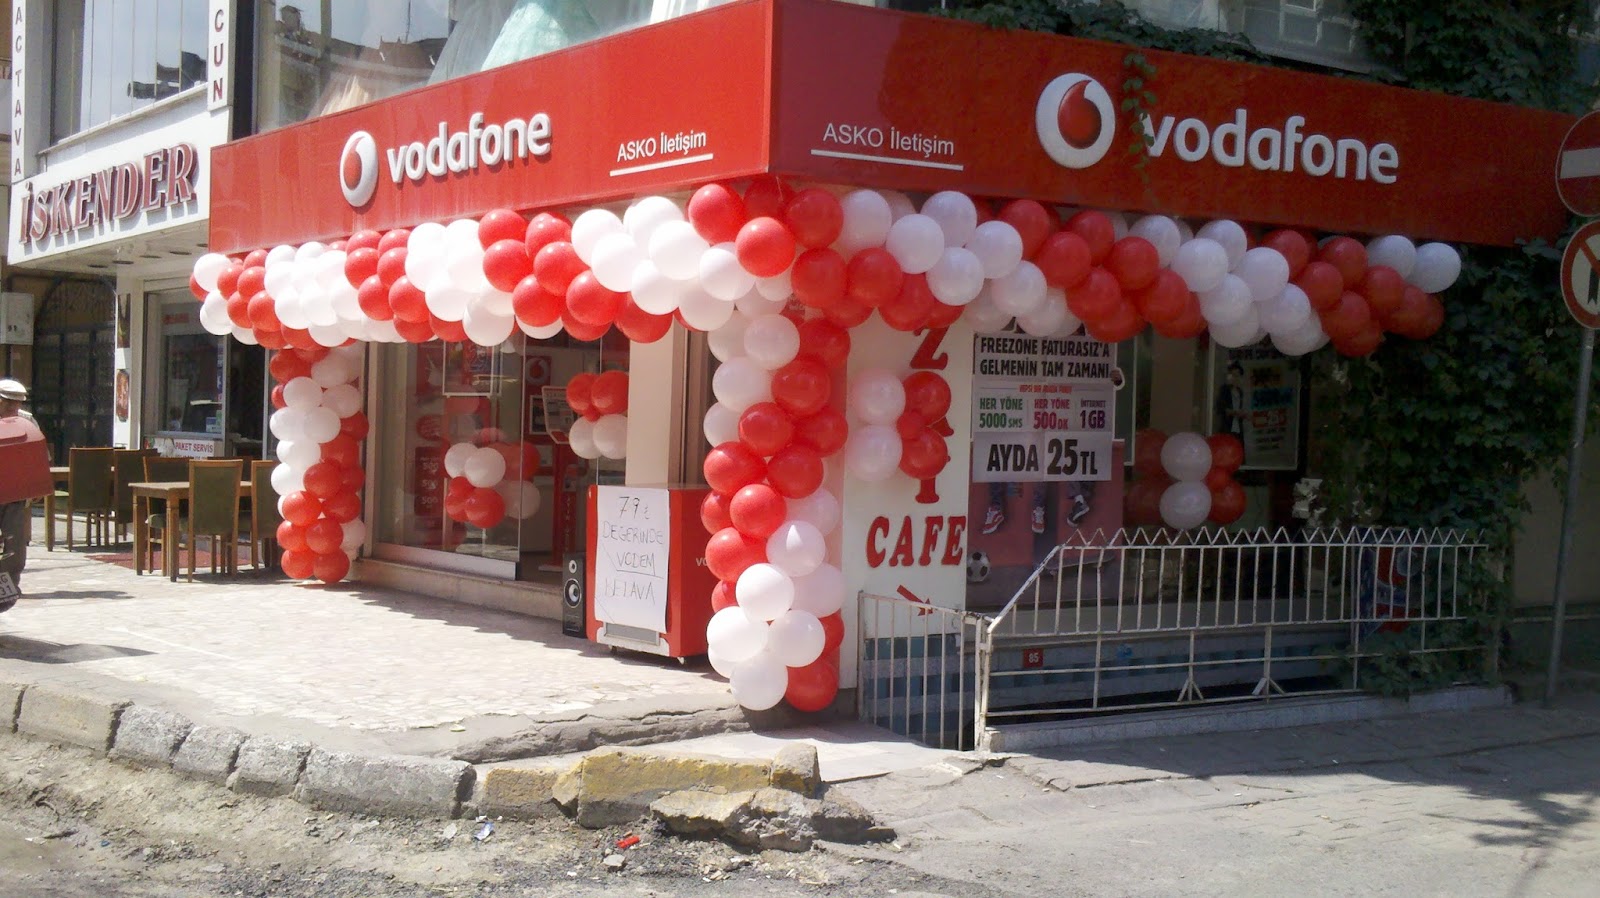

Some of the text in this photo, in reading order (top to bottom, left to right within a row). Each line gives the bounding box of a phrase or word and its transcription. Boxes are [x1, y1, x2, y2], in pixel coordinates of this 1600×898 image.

[386, 111, 551, 184] vodafone
[617, 129, 707, 162] ASKO İletişim
[823, 122, 954, 158] ASKO İletişim
[1138, 108, 1399, 184] vodafone
[19, 143, 198, 244] İSKENDER
[980, 337, 1110, 357] FREEZONE FATURASIZ'A
[980, 357, 1110, 379] GELMENİN TAM ZAMANI
[979, 397, 1023, 411] HER YÖNE
[1034, 397, 1070, 410] HER YÖNE
[979, 413, 1023, 429] 5000 SMS
[1033, 411, 1057, 430] 500
[986, 444, 1039, 472] AYDA
[1047, 438, 1078, 475] 25
[866, 515, 967, 568] CAFE
[1028, 653, 1039, 663] 85
